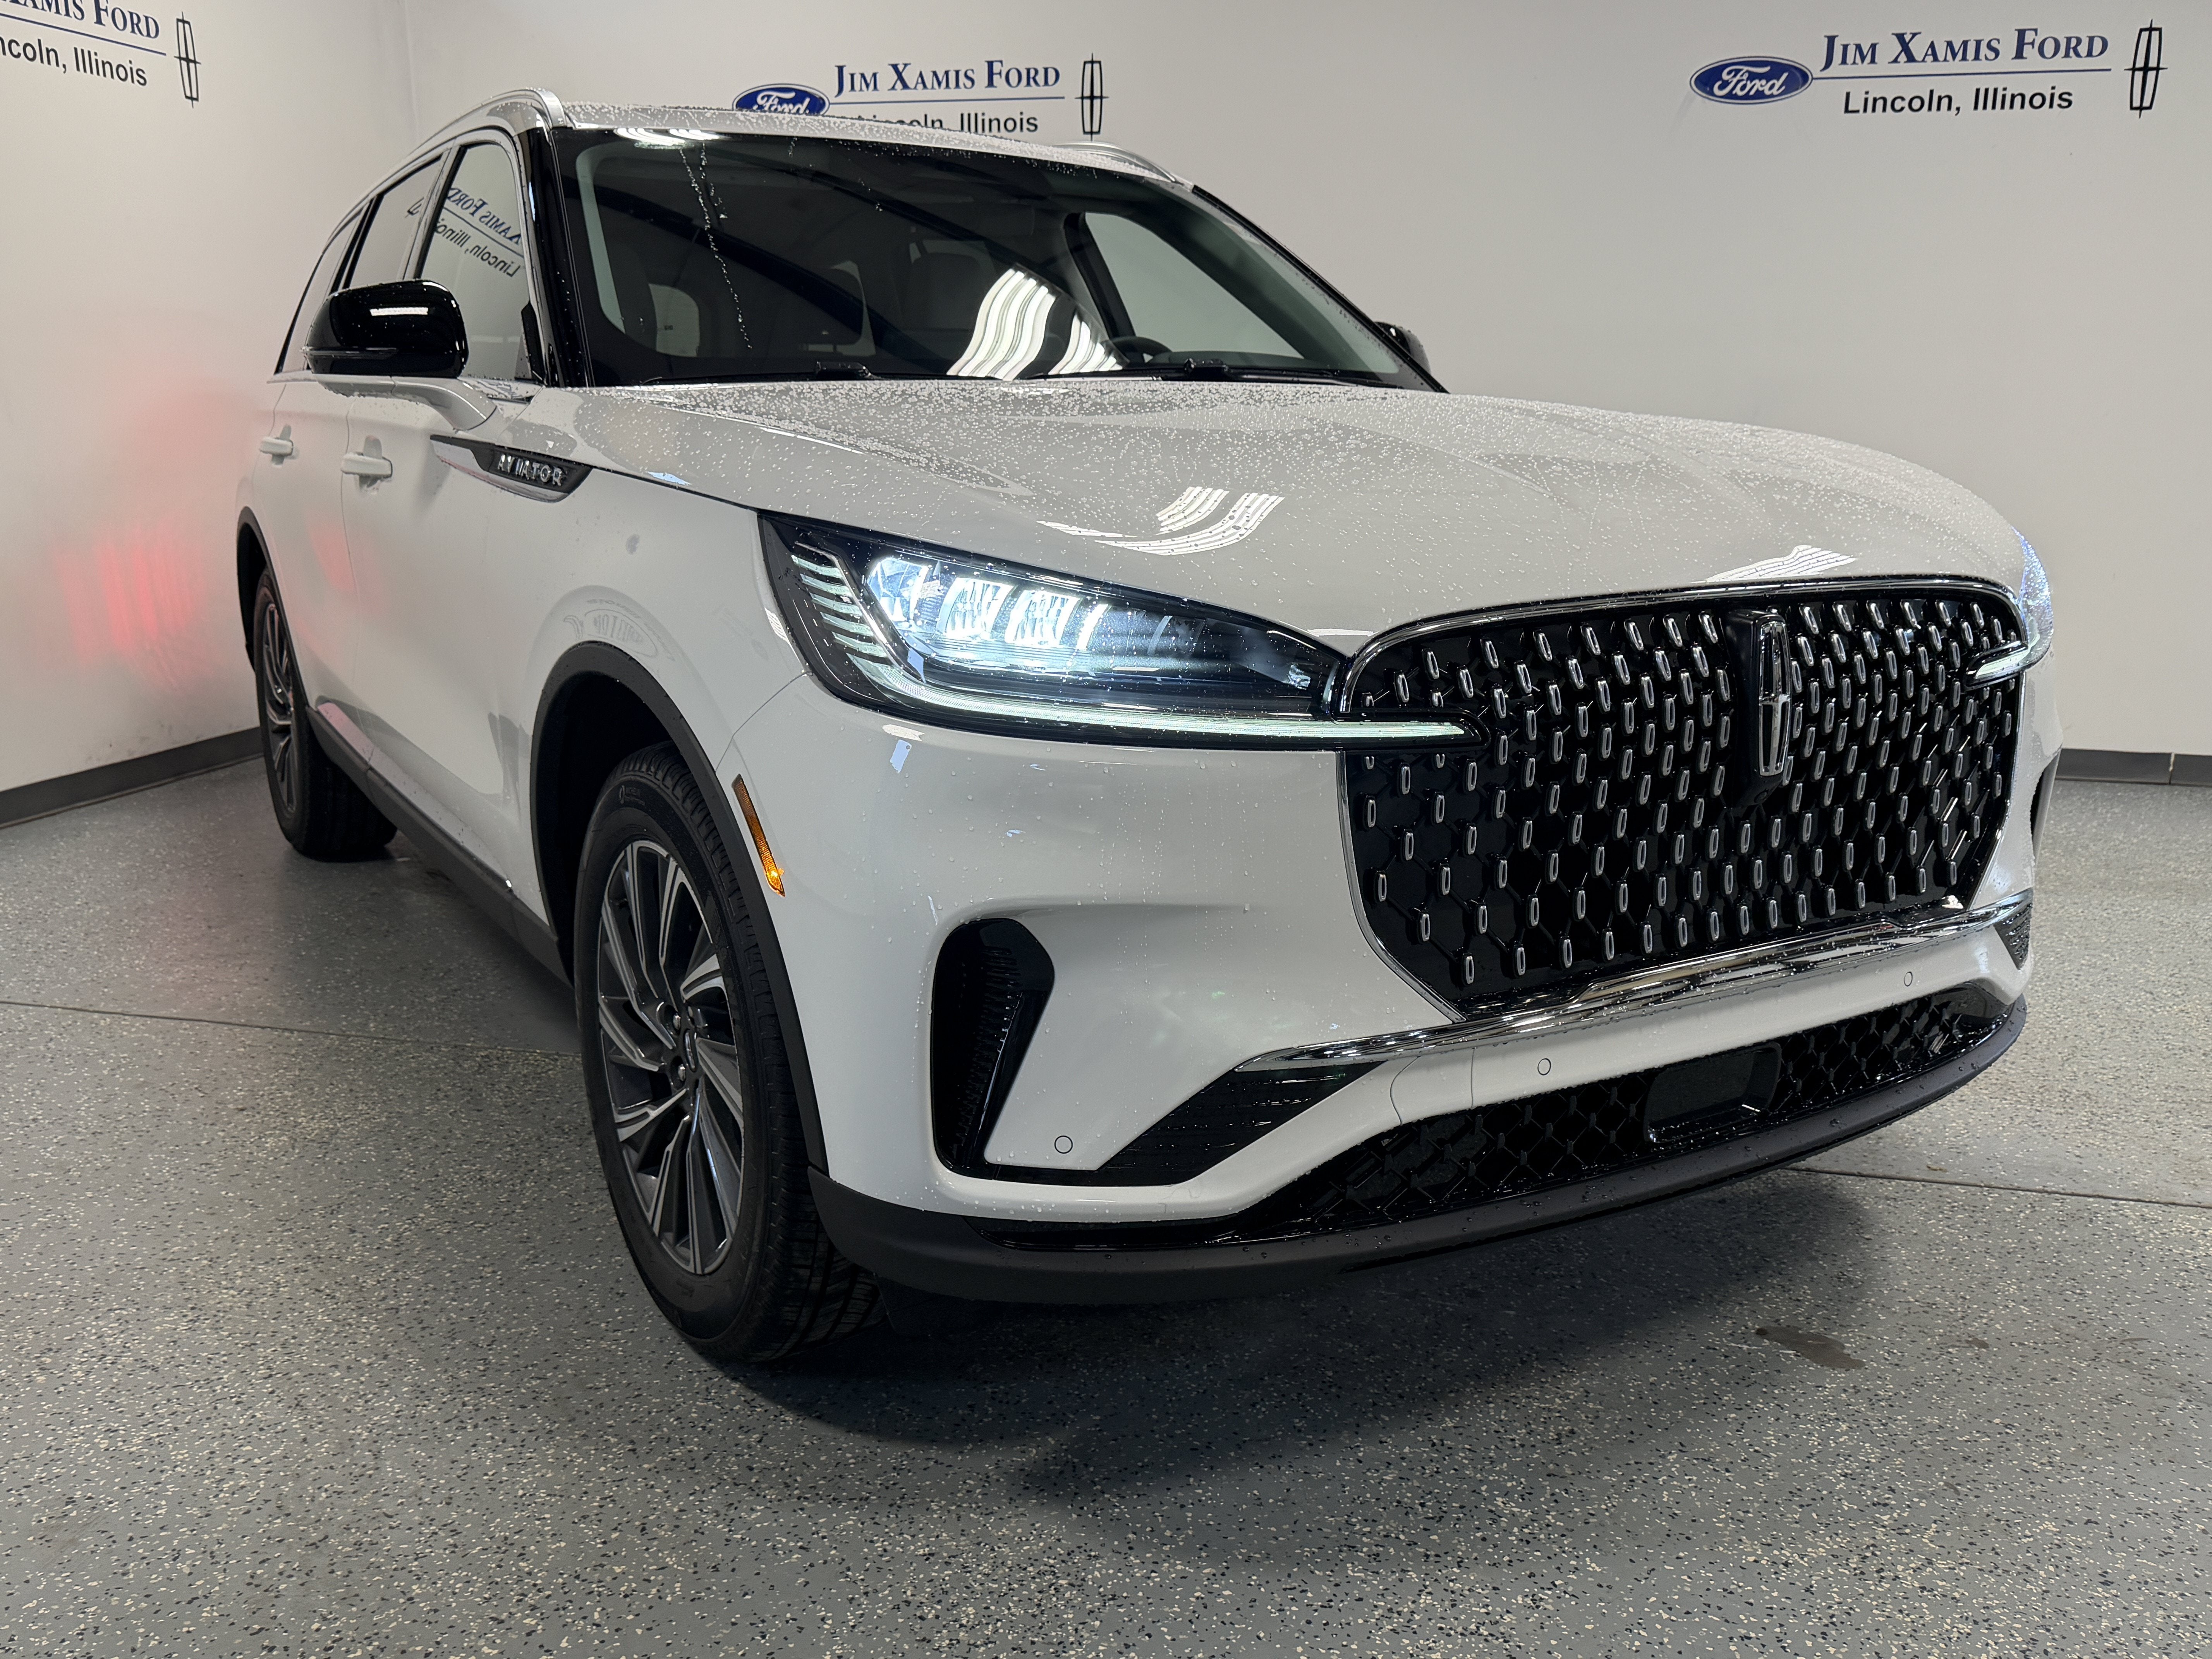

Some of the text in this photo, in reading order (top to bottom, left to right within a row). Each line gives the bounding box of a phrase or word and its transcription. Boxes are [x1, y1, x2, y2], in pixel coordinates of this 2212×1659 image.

[0, 0, 160, 39] MIS FORD
[74, 47, 147, 86] Illinois
[1820, 27, 2109, 72] JIM XAMIS FORD
[834, 60, 1060, 98] JIM XAMIS FORD
[1713, 65, 1789, 96] Ford
[1843, 86, 2073, 116] Lincoln, Illinois
[960, 112, 1039, 133] Illinois
[498, 454, 563, 486] AVIATOR
